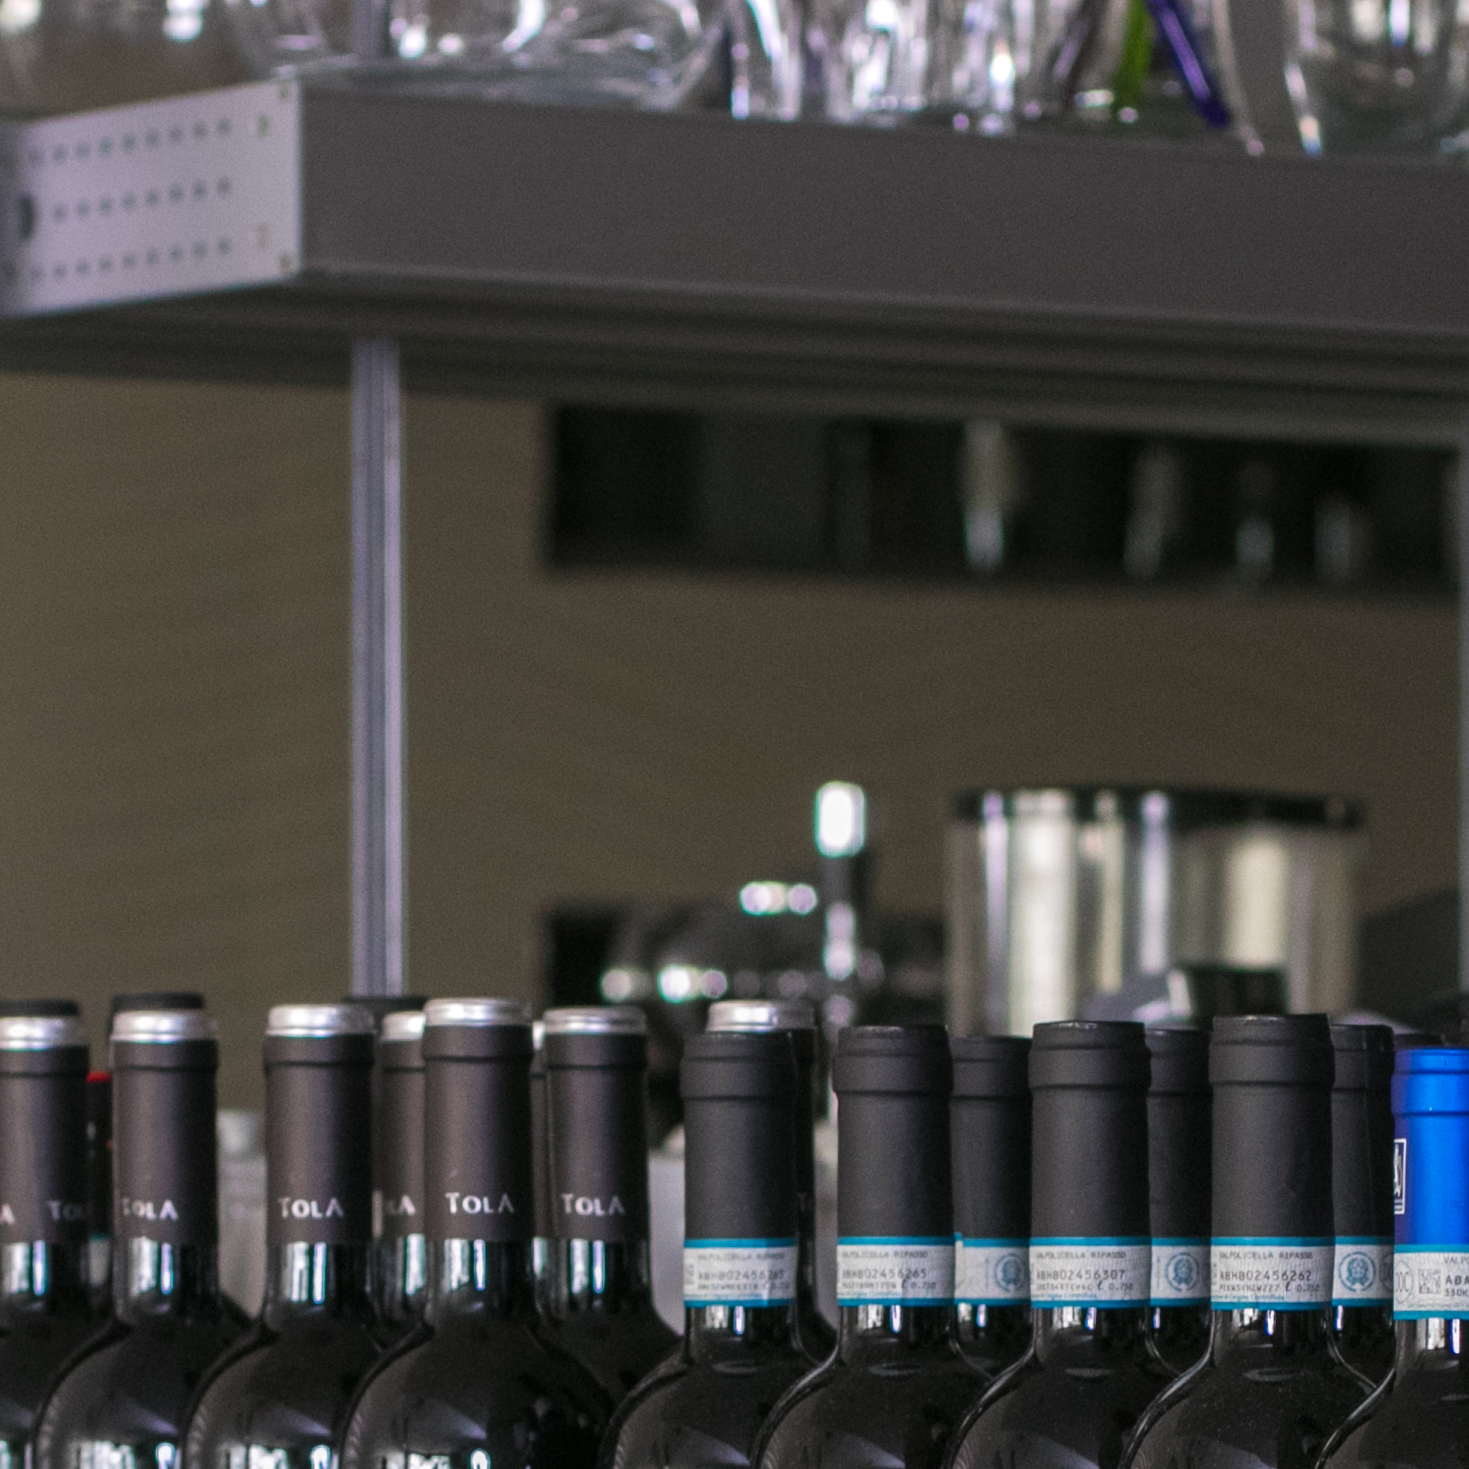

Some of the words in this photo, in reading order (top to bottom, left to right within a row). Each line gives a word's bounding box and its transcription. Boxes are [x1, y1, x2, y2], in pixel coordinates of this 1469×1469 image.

[278, 1196, 344, 1219] TOLA
[444, 1192, 514, 1214] TOLA
[561, 1193, 626, 1216] TOLA
